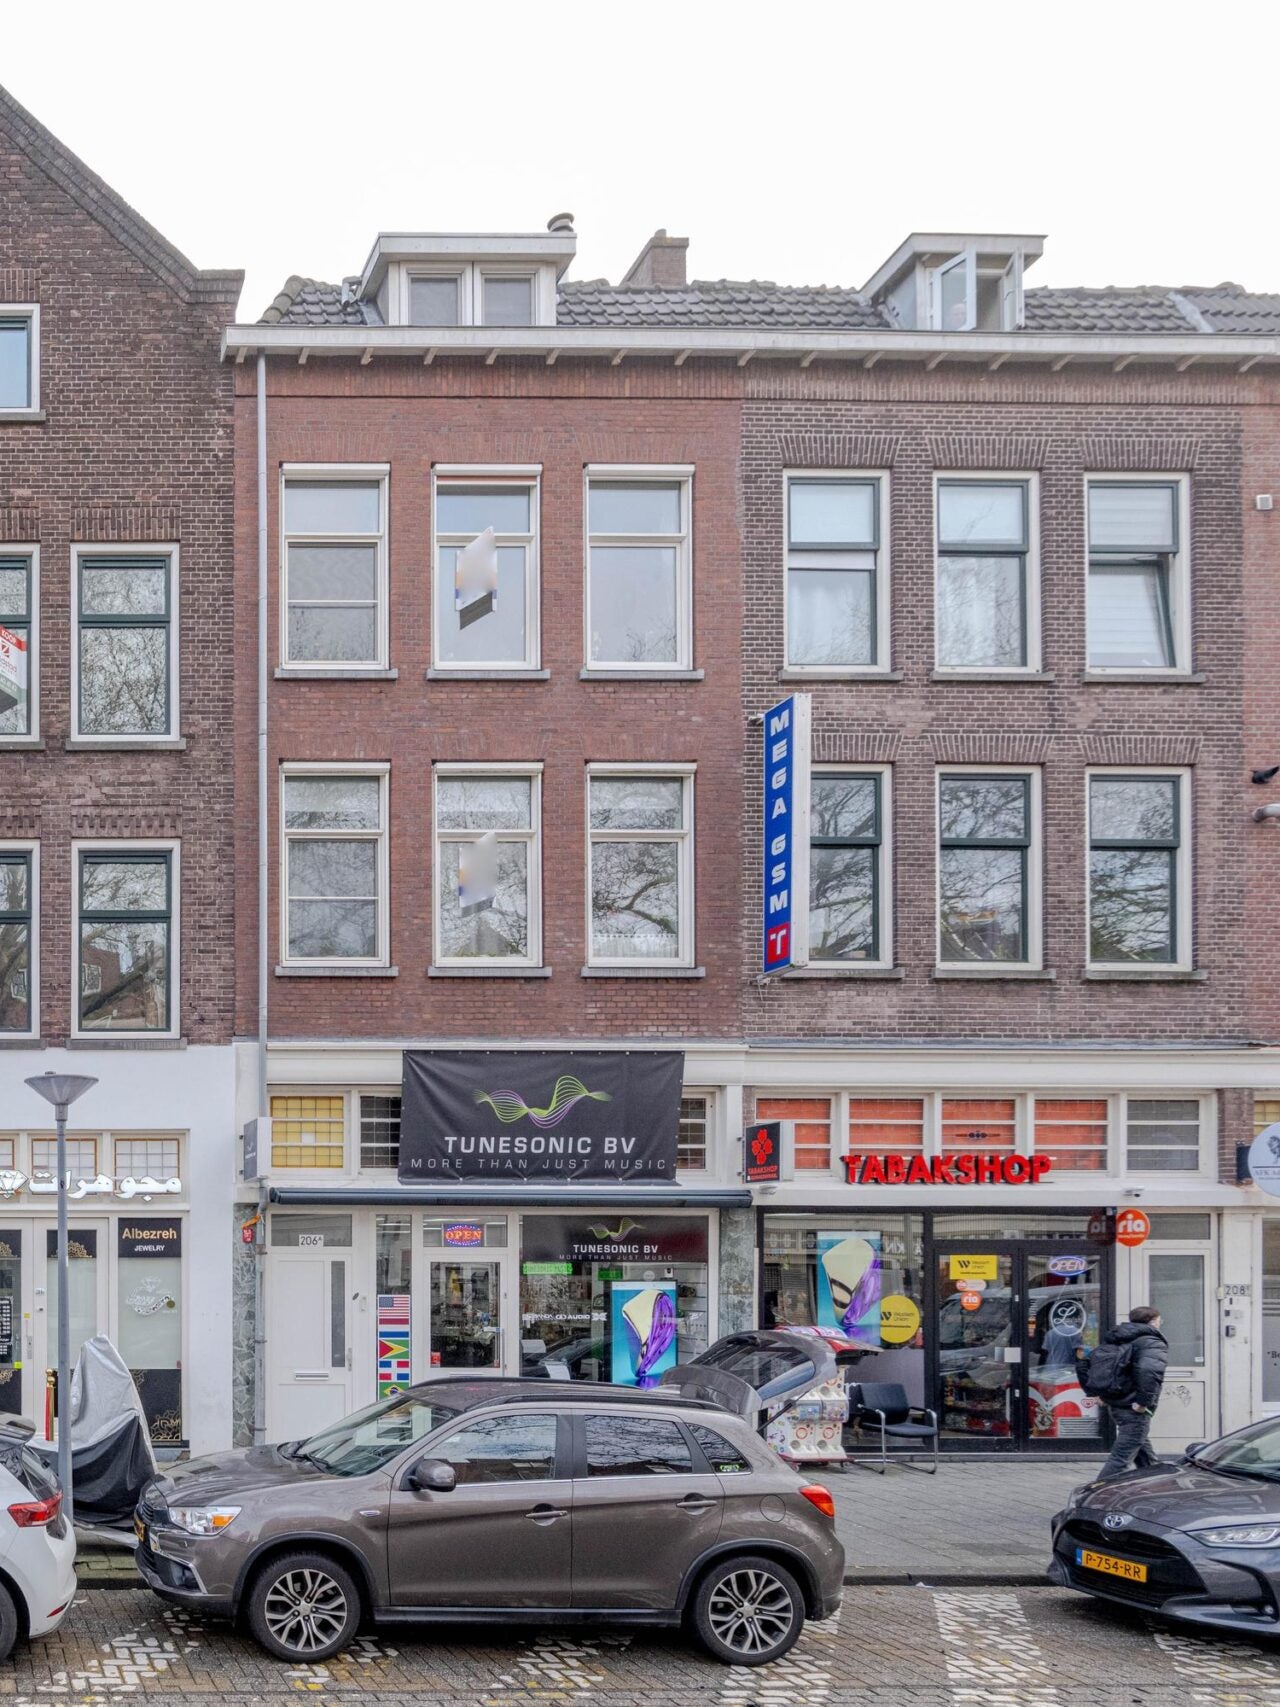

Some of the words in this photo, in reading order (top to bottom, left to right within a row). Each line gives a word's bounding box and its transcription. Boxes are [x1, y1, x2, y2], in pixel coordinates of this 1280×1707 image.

[770, 709, 789, 819] MEGA
[770, 833, 788, 914] GSM
[444, 1136, 592, 1154] TUNESONIC
[604, 1137, 636, 1154] BV
[411, 1158, 463, 1169] MORE
[478, 1159, 528, 1169] THAN
[542, 1159, 590, 1169] JUST
[604, 1159, 666, 1170] MUSIC
[841, 1154, 1052, 1185] TABAKSHOP
[1119, 1213, 1145, 1233] ria
[122, 1227, 177, 1240] Albezreh
[445, 1230, 482, 1240] OPEN
[134, 1244, 165, 1253] JEWELRY
[573, 1244, 639, 1253] TUNESONIC
[643, 1245, 659, 1253] BV
[1049, 1260, 1085, 1272] OPEN
[1085, 1553, 1141, 1579] P-754-RR
